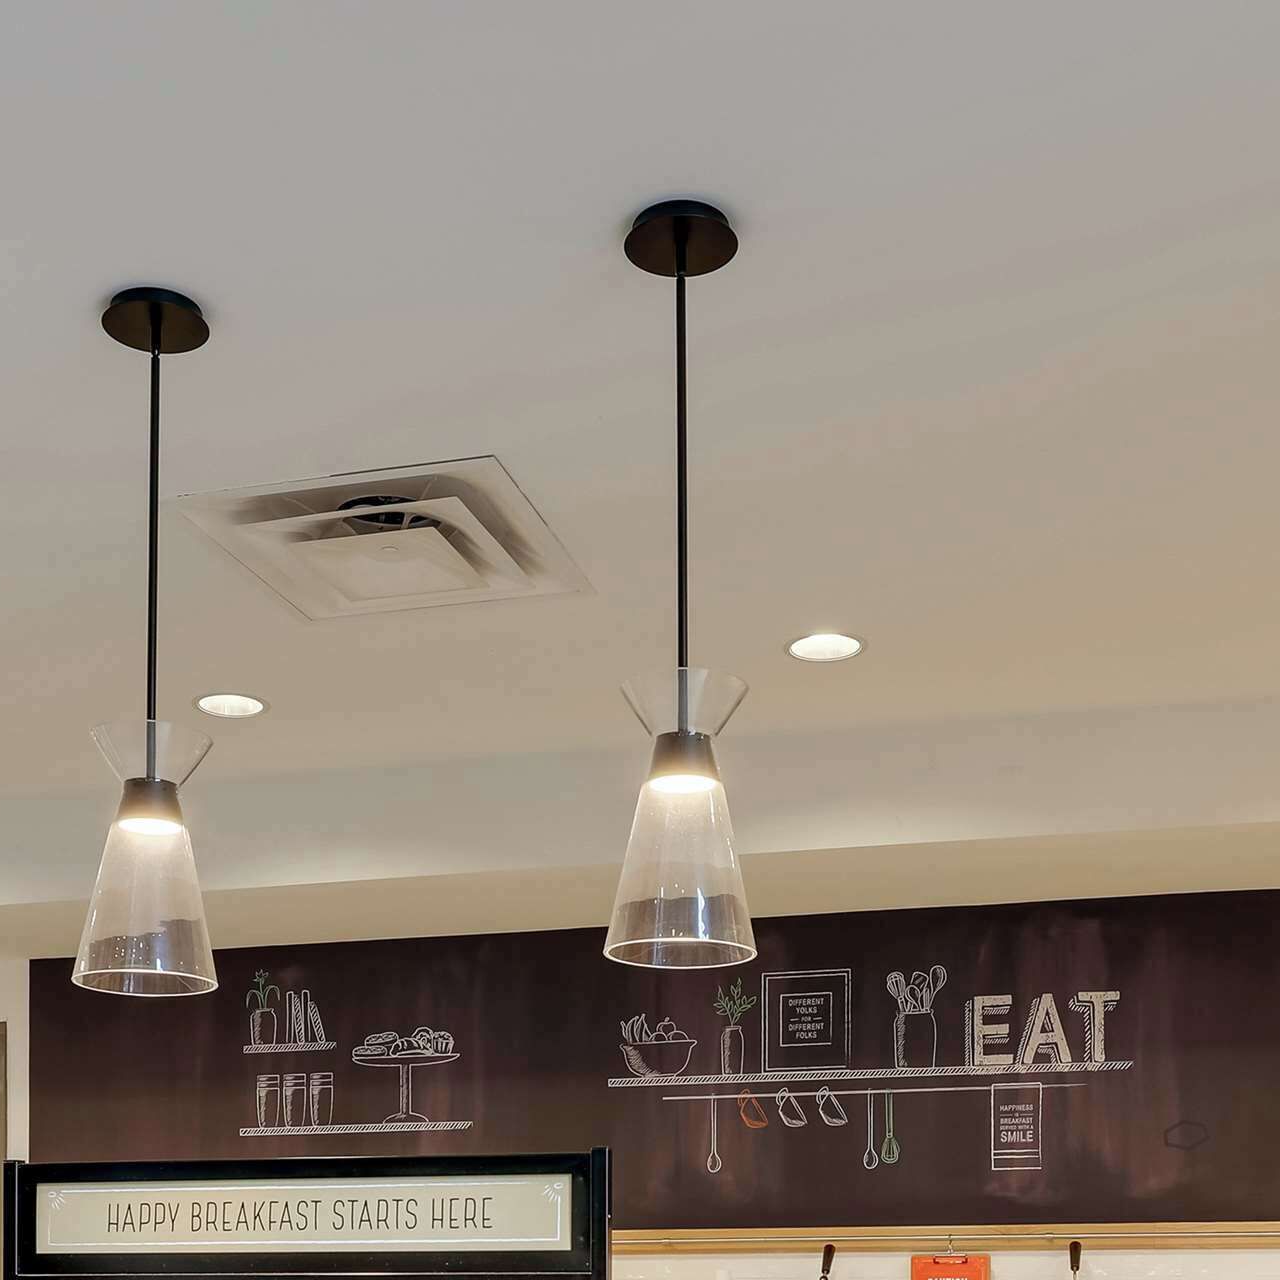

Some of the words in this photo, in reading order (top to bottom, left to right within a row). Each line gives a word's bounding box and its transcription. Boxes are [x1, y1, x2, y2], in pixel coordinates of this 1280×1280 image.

[788, 997, 824, 1007] DIFFERENT
[795, 1006, 818, 1015] YOLKS
[788, 1022, 825, 1032] DIFFERENT
[967, 990, 1120, 1066] EAT
[795, 1031, 817, 1039] FOLKS
[1000, 1130, 1033, 1143] SMILE
[106, 1202, 180, 1233] HAPPY
[190, 1200, 322, 1232] BREAKFAST
[331, 1198, 419, 1231] STARTS
[431, 1197, 493, 1230] HERE
